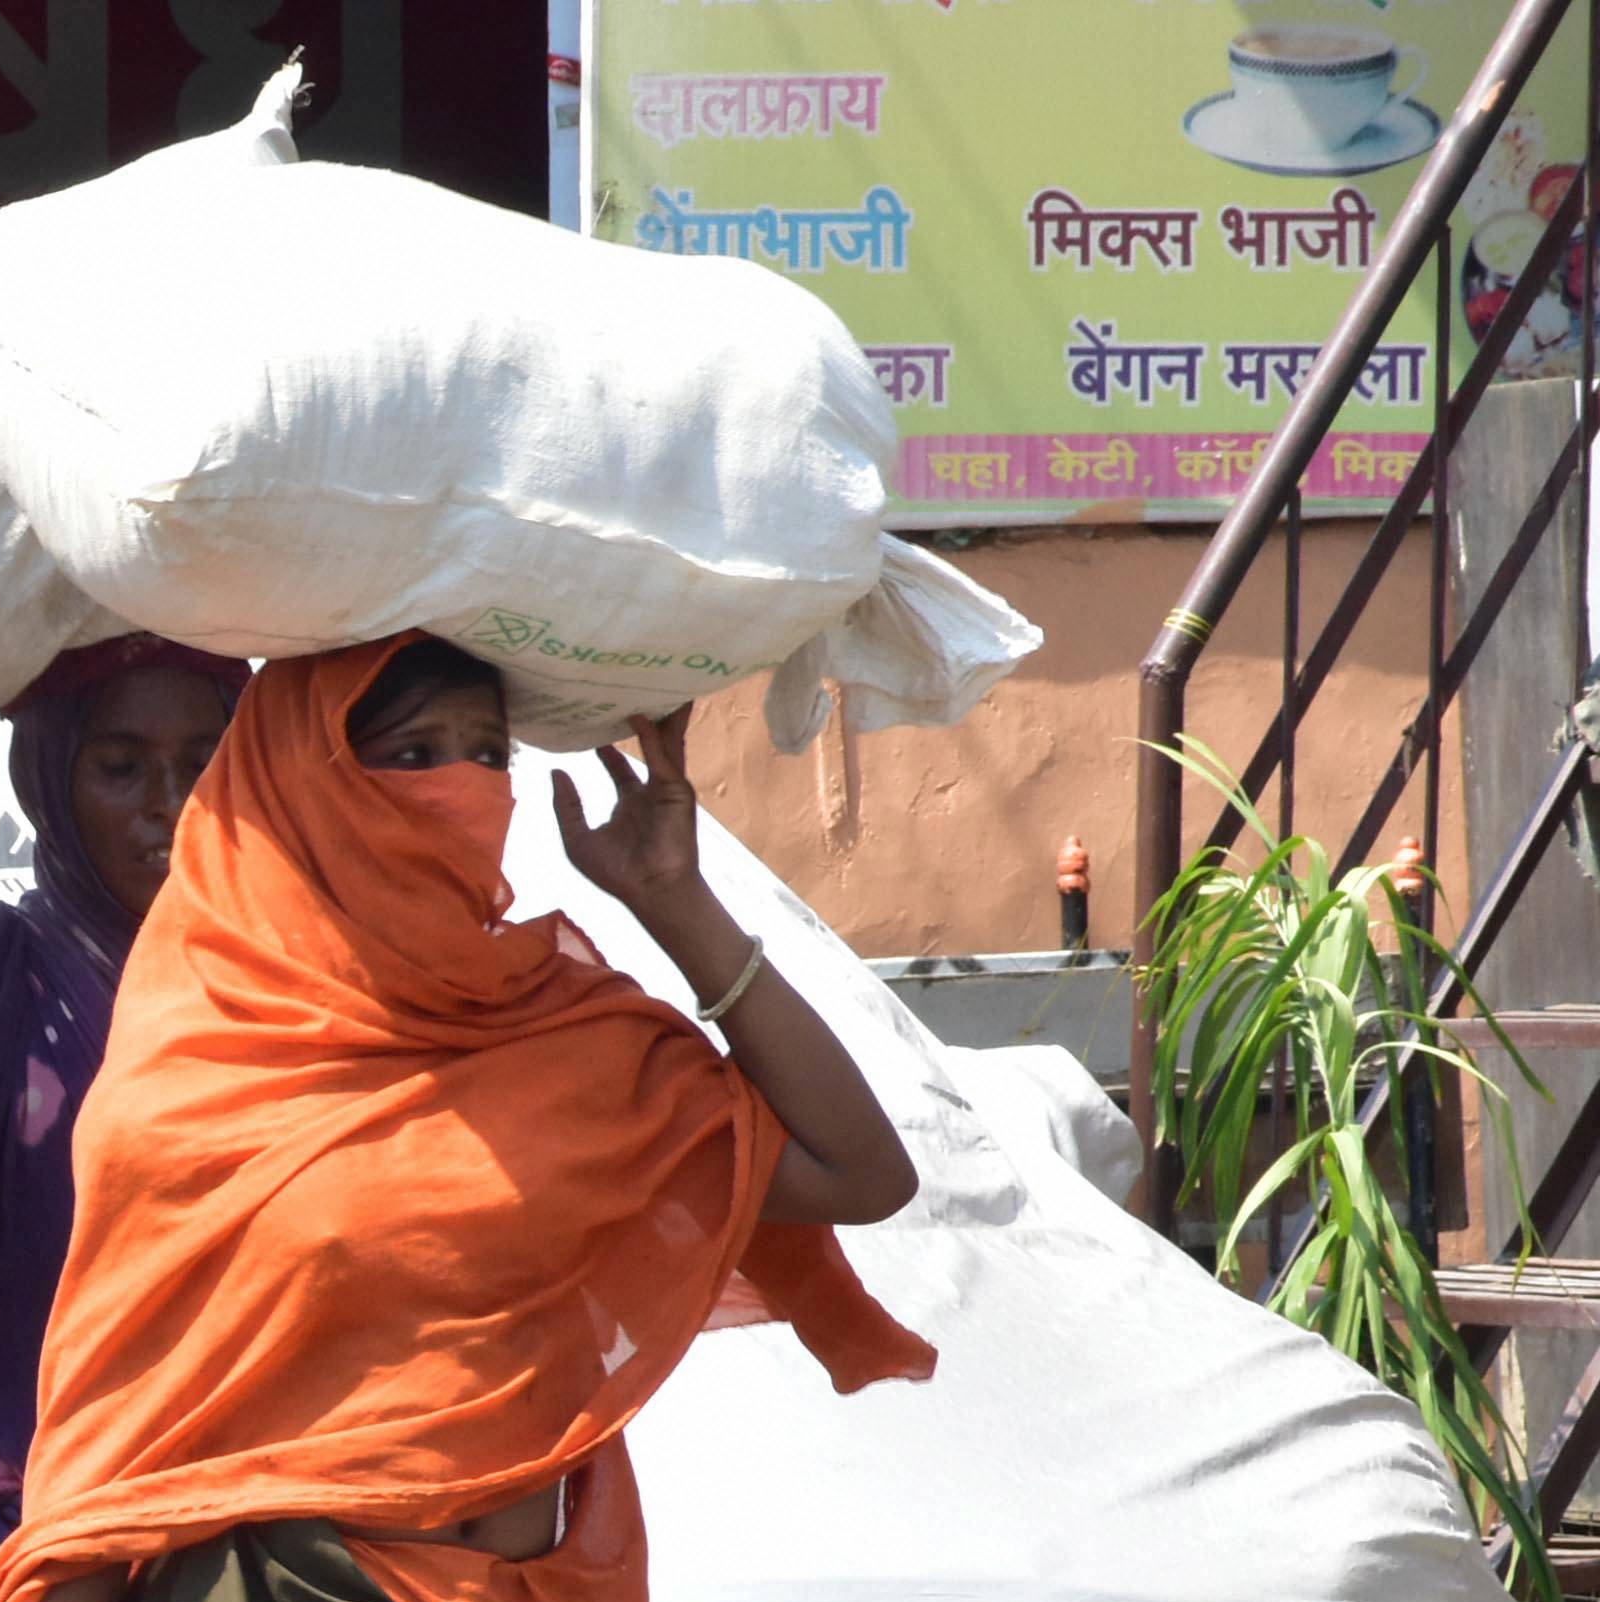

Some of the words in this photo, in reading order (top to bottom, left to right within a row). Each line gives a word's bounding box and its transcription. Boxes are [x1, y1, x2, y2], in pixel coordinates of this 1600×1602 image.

[630, 75, 885, 143] दालफ्राय
[1028, 189, 1198, 267] मिक्स
[1221, 187, 1376, 268] भाजी
[1068, 320, 1204, 401] बेंगन
